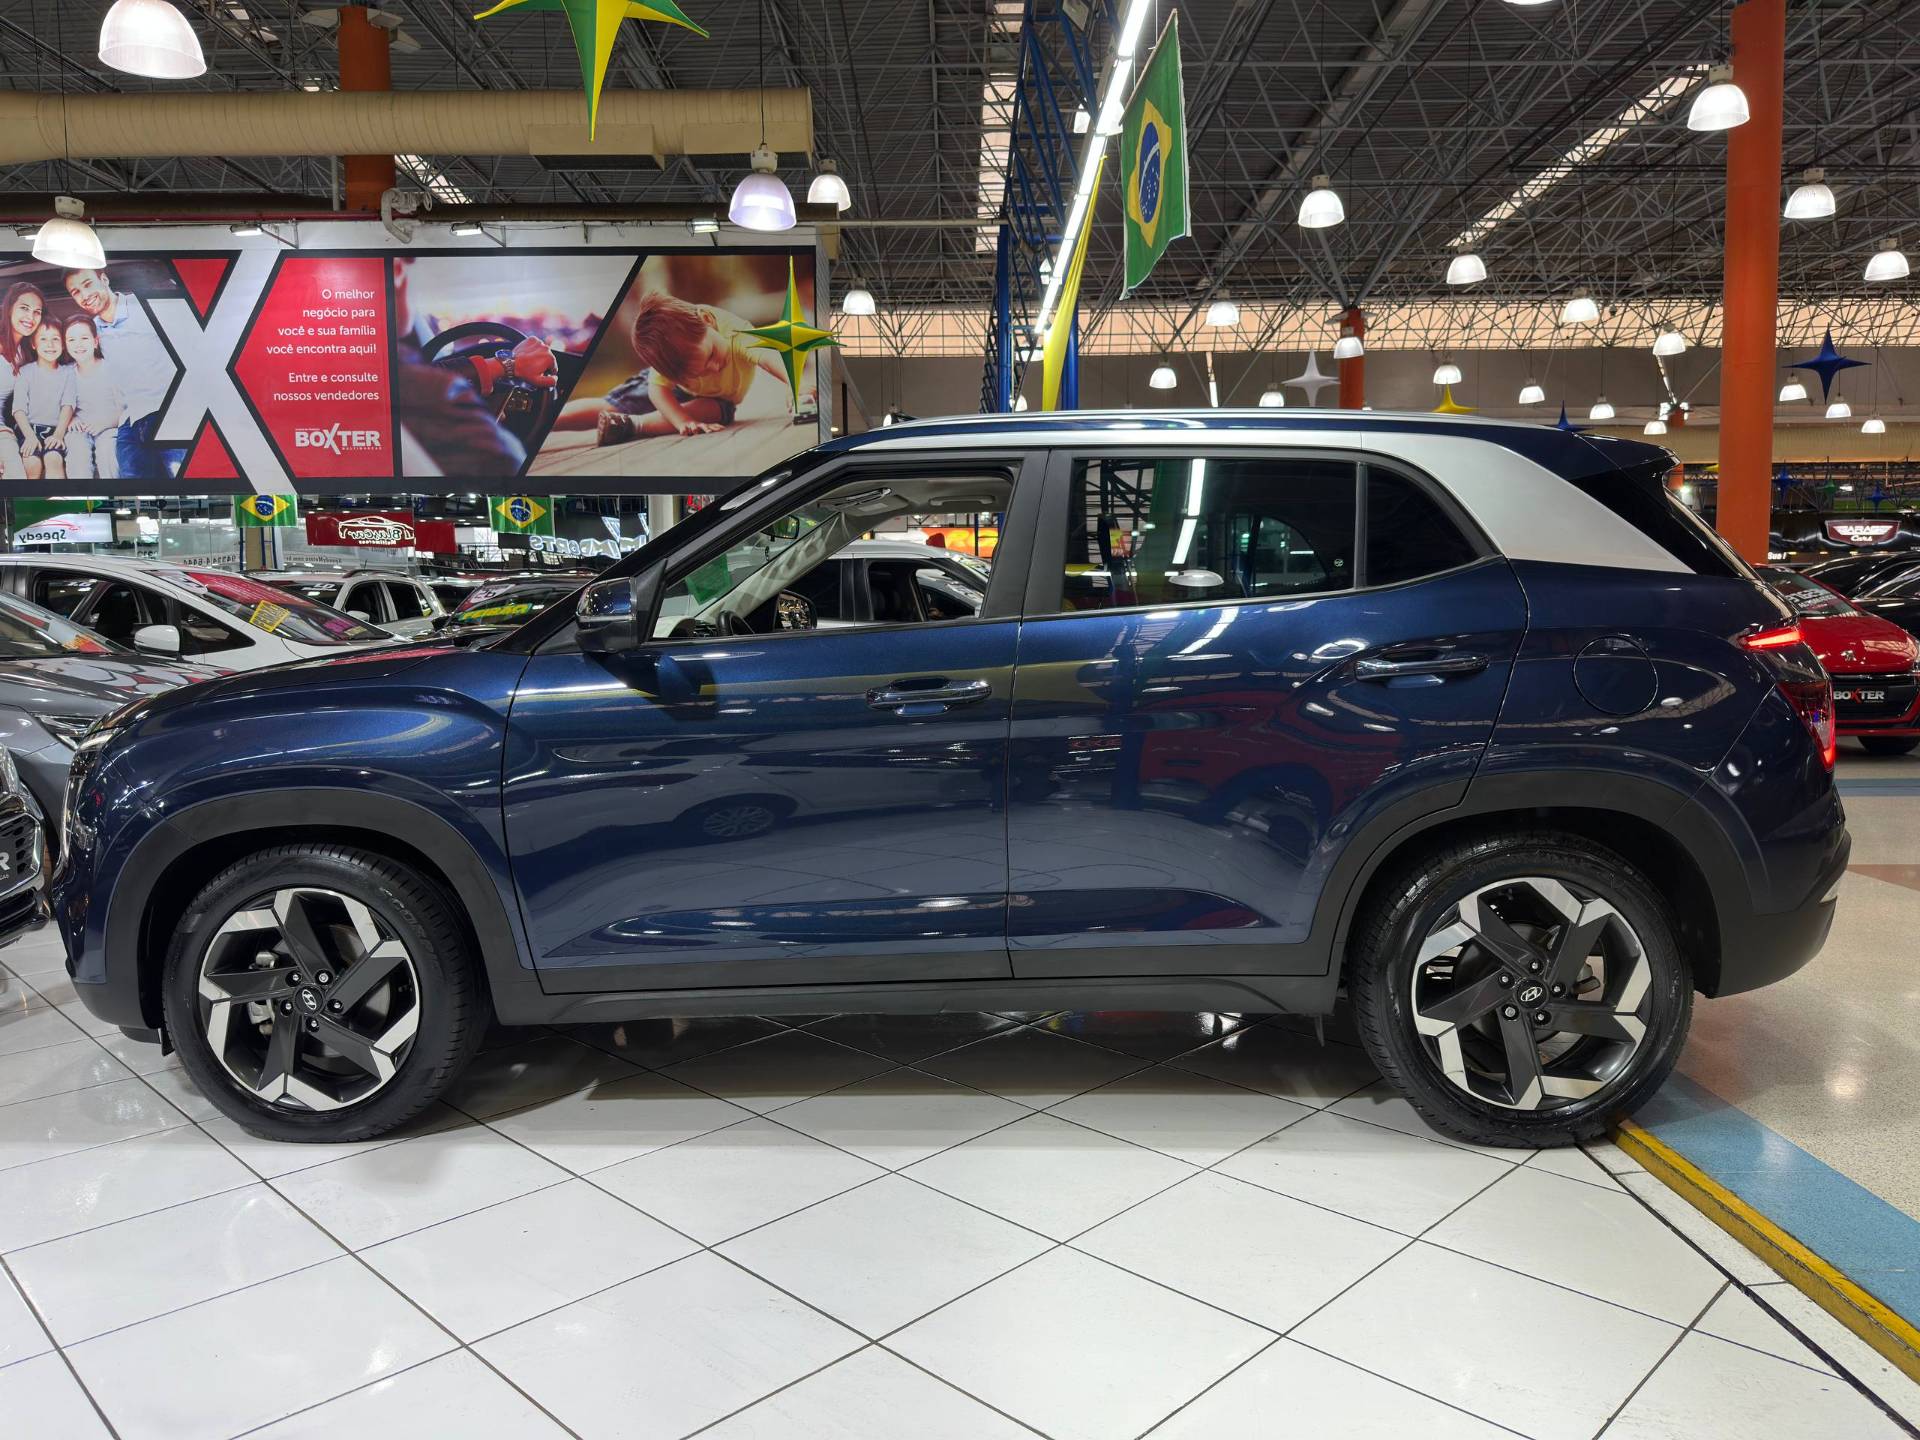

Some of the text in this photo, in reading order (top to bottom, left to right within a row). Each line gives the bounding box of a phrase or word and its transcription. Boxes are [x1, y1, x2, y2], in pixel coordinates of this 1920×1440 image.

[321, 289, 375, 300] O melhor
[302, 308, 376, 320] negócio para
[277, 325, 376, 336] você e sua família
[266, 344, 377, 356] você encontra aqui!
[288, 372, 379, 383] Entre e consulte
[273, 390, 380, 401] nossos vendedores
[295, 423, 382, 455] BOXTER
[1833, 688, 1885, 704] BOXTER
